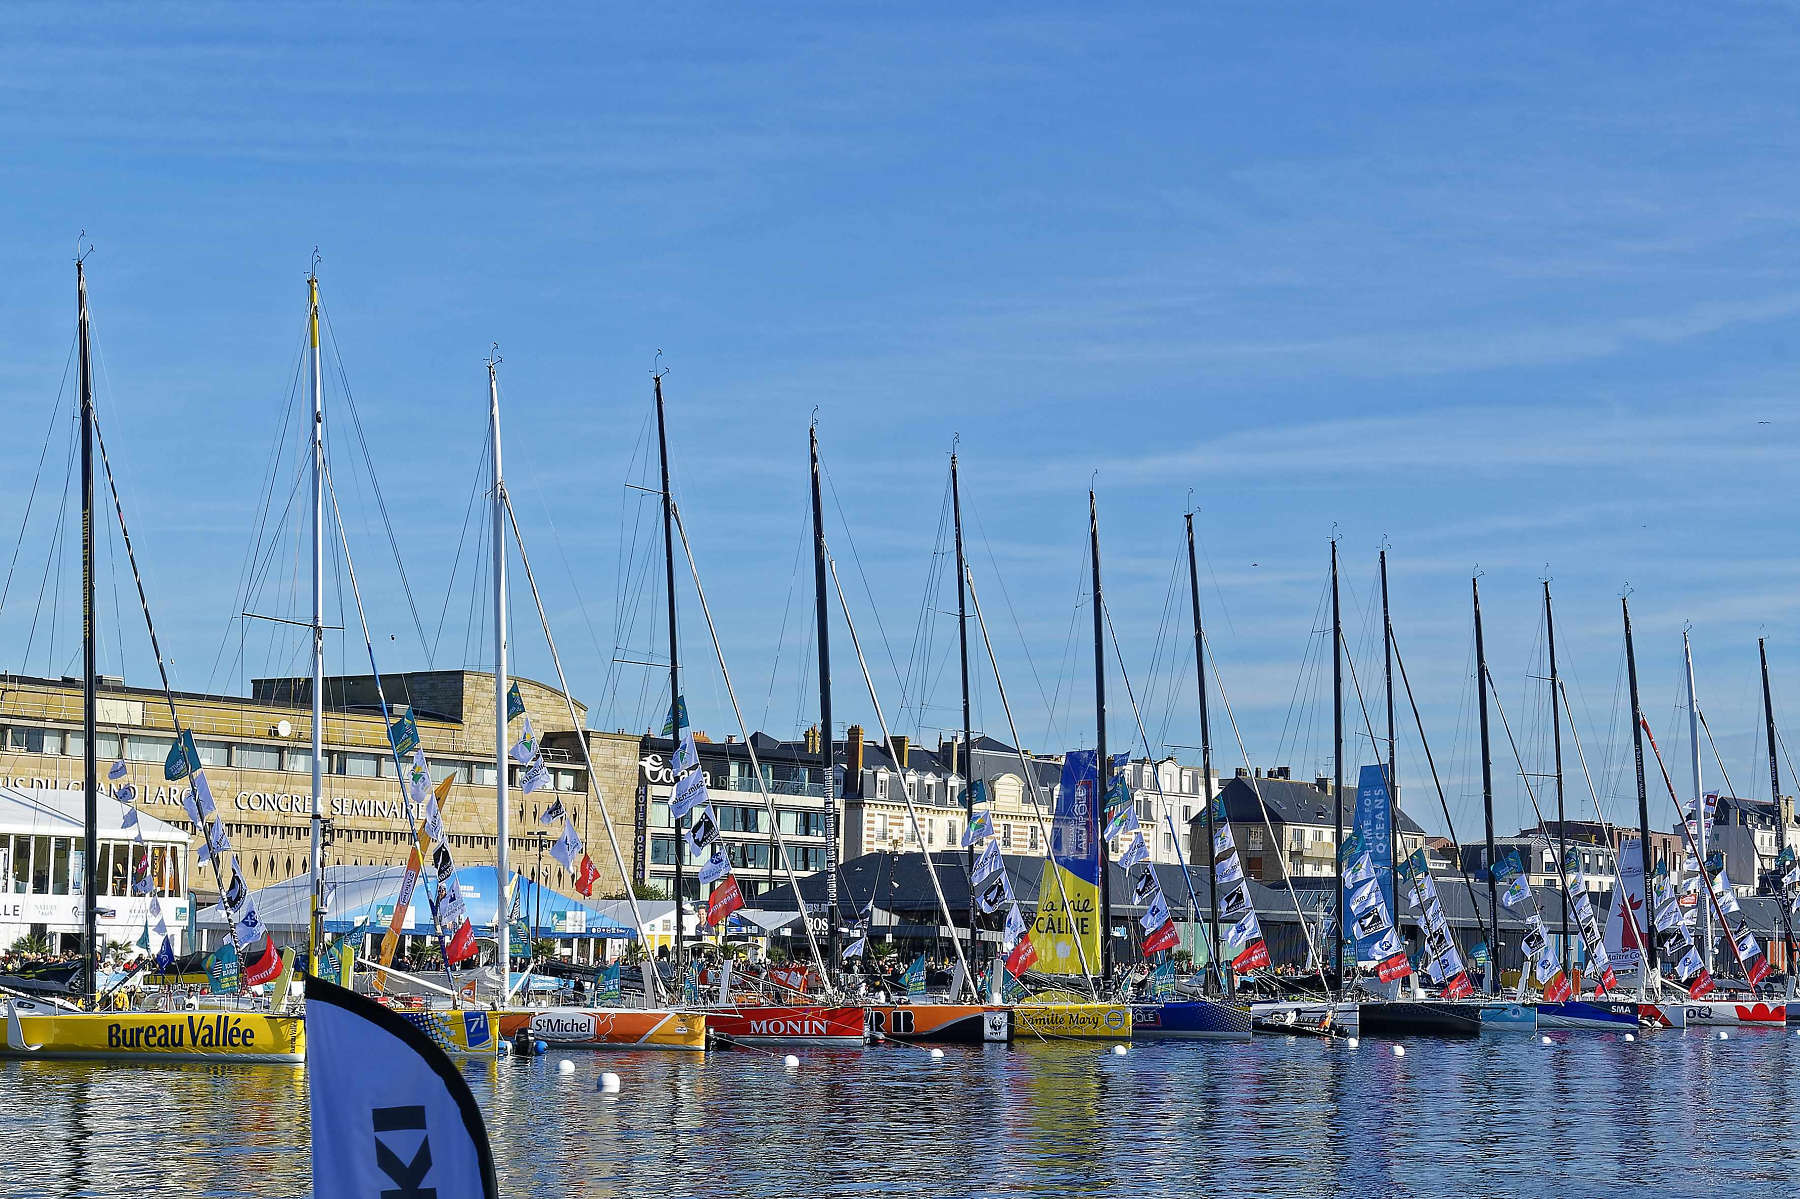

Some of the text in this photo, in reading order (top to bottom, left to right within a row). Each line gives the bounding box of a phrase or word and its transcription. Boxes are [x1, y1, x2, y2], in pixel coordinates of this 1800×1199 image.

[1374, 787, 1385, 855] OCEANS
[1611, 1005, 1631, 1013] SMA
[750, 1020, 828, 1035] MONIN
[869, 1010, 915, 1034] RB
[1069, 1014, 1099, 1029] Mary
[108, 1015, 255, 1048] Bureau Vallée
